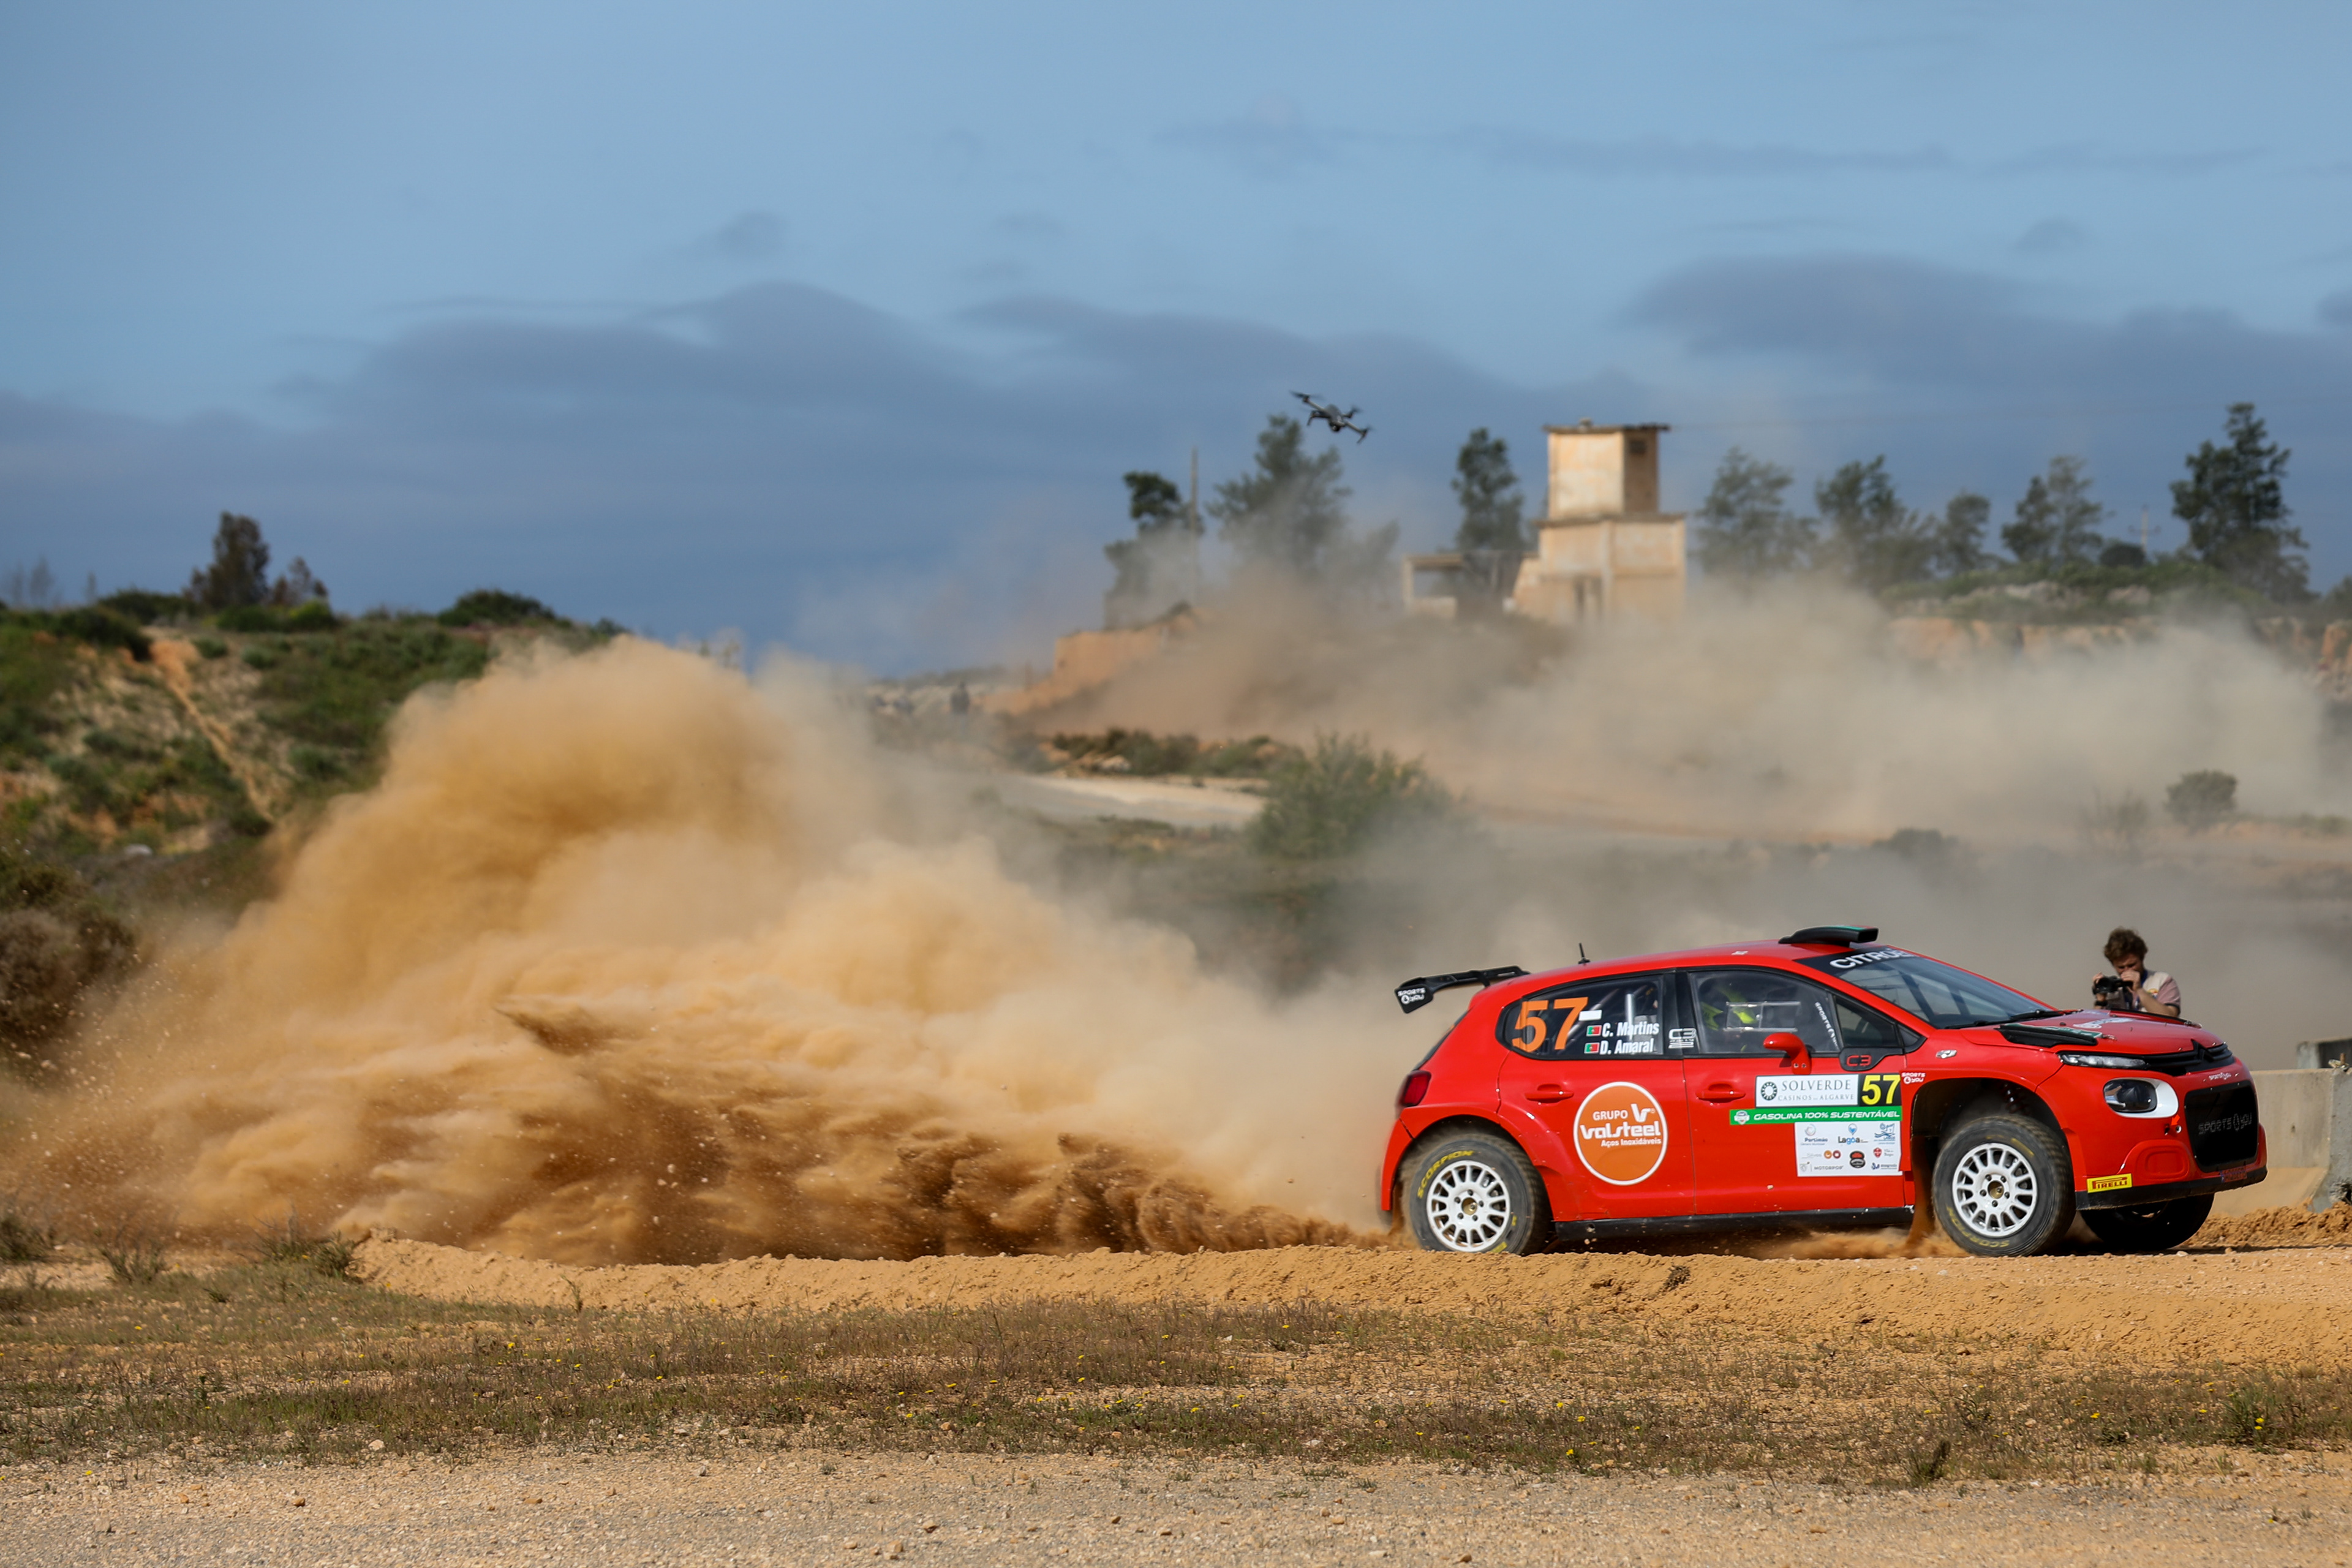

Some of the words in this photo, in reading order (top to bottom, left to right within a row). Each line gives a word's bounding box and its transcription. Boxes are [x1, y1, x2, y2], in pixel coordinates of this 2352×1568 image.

[1830, 948, 1915, 968] CITROË
[1397, 987, 1426, 997] SPORTS
[1512, 997, 1589, 1053] 57
[1602, 1022, 1614, 1038] C.
[1616, 1021, 1660, 1036] Martins
[1668, 1028, 1697, 1040] C3
[1599, 1040, 1612, 1055] D.
[1614, 1038, 1654, 1054] Amaral
[1846, 1055, 1872, 1067] C3
[1781, 1079, 1851, 1091] SOLVERDE
[1861, 1074, 1901, 1106] 57
[1593, 1109, 1628, 1121] GRUPO
[1753, 1112, 1803, 1121] GASOLINA
[1830, 1110, 1901, 1118] SUSTENTÁVEL
[2198, 1117, 2231, 1135] SPORTS
[1600, 1139, 1619, 1148] Aços
[1417, 1150, 1474, 1199] SCORPION
[2092, 1177, 2128, 1189] PIRELLI
